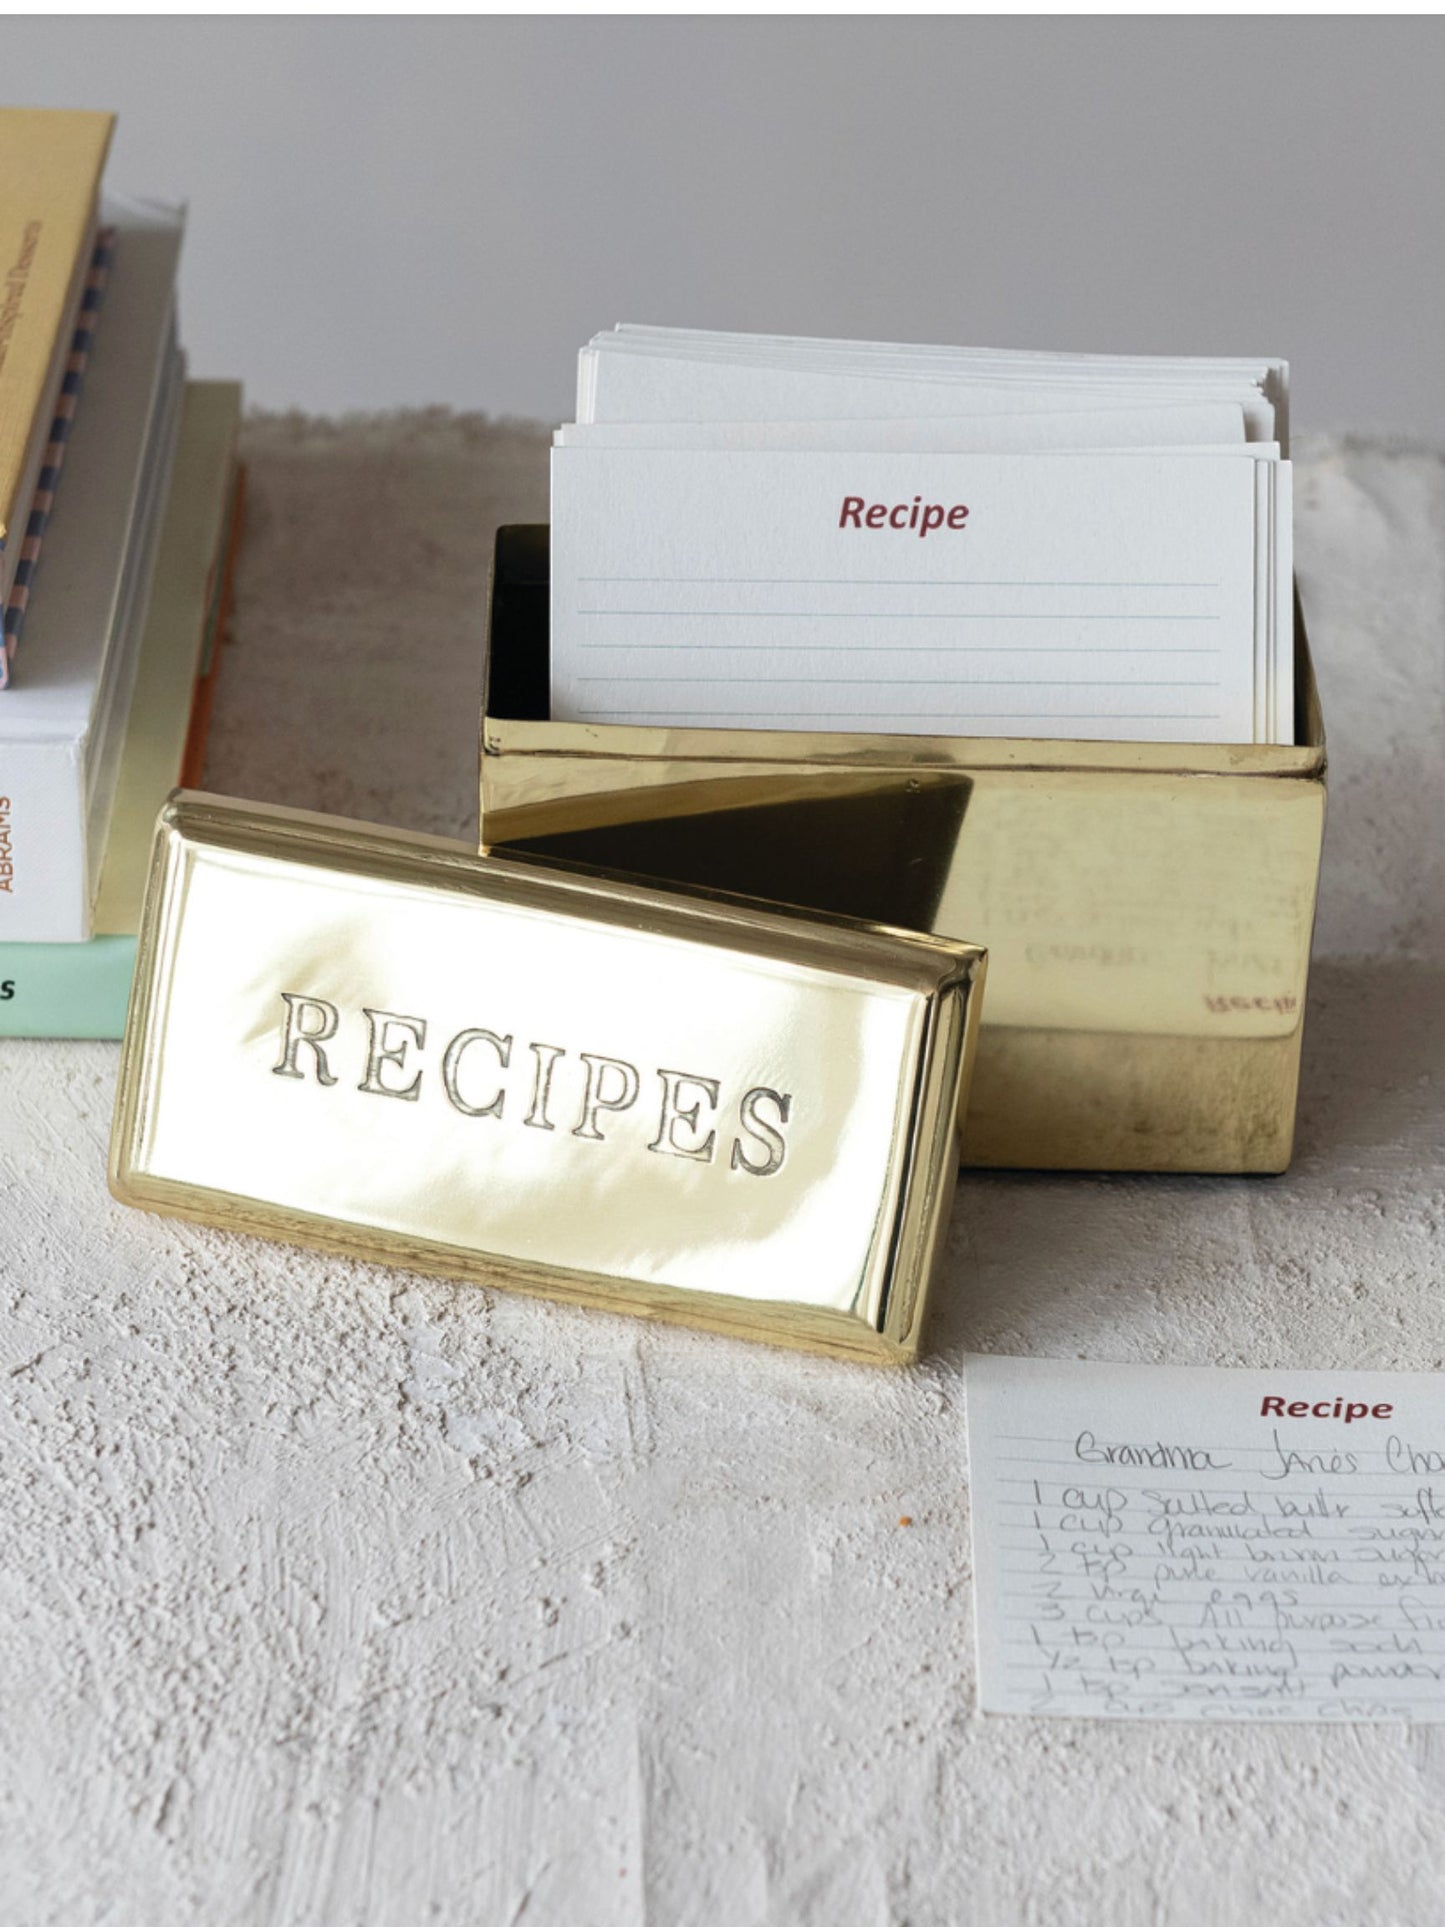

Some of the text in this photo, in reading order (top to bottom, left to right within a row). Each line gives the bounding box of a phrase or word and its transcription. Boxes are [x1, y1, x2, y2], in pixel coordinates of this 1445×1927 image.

[838, 496, 970, 538] Recipe
[0, 796, 13, 893] ABRAMS
[272, 992, 792, 1177] RECIPES
[1260, 1396, 1394, 1423] Recipe
[1075, 1430, 1232, 1470] Grandma
[1034, 1479, 1042, 1505] 1
[1062, 1488, 1128, 1518] cup
[1034, 1510, 1041, 1530] 1
[1060, 1514, 1123, 1539] cup
[1148, 1514, 1313, 1552] granulated
[1038, 1553, 1057, 1575] 2
[1244, 1564, 1351, 1586] vanilla
[1070, 1542, 1134, 1563] cup
